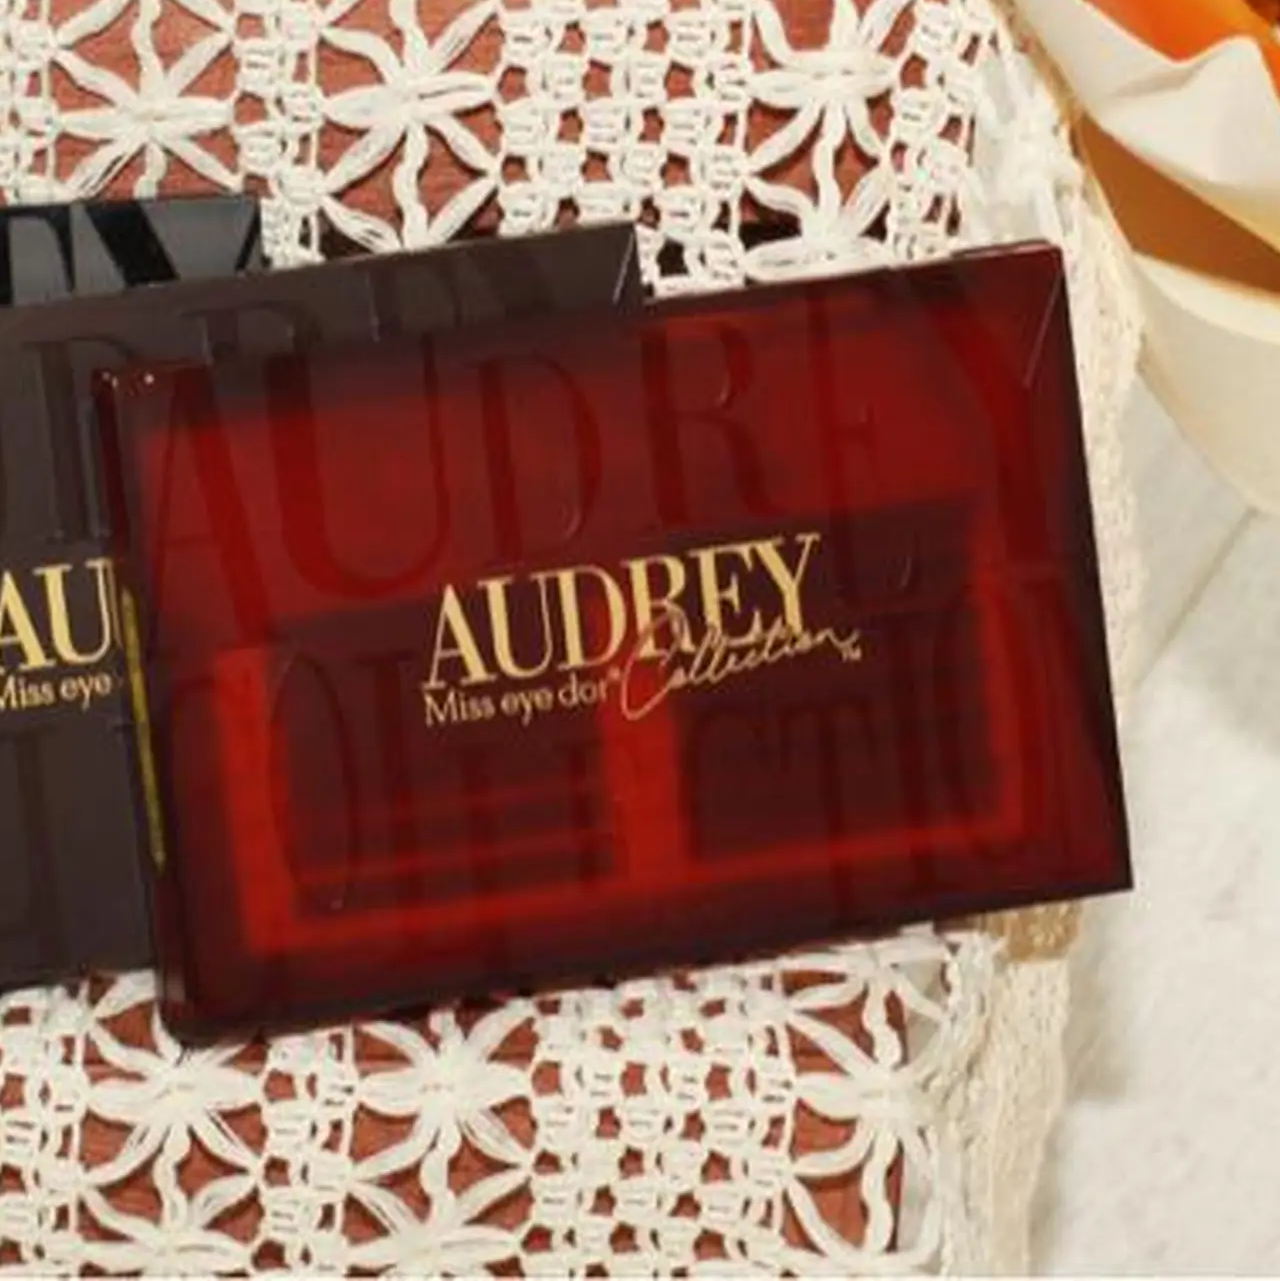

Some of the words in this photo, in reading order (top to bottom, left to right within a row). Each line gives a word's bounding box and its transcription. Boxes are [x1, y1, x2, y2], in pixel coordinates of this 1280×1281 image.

[422, 532, 820, 690] AUDREY
[424, 688, 496, 726] Miss
[500, 684, 553, 726] eye
[623, 605, 860, 721] Collection
[59, 671, 112, 712] eye
